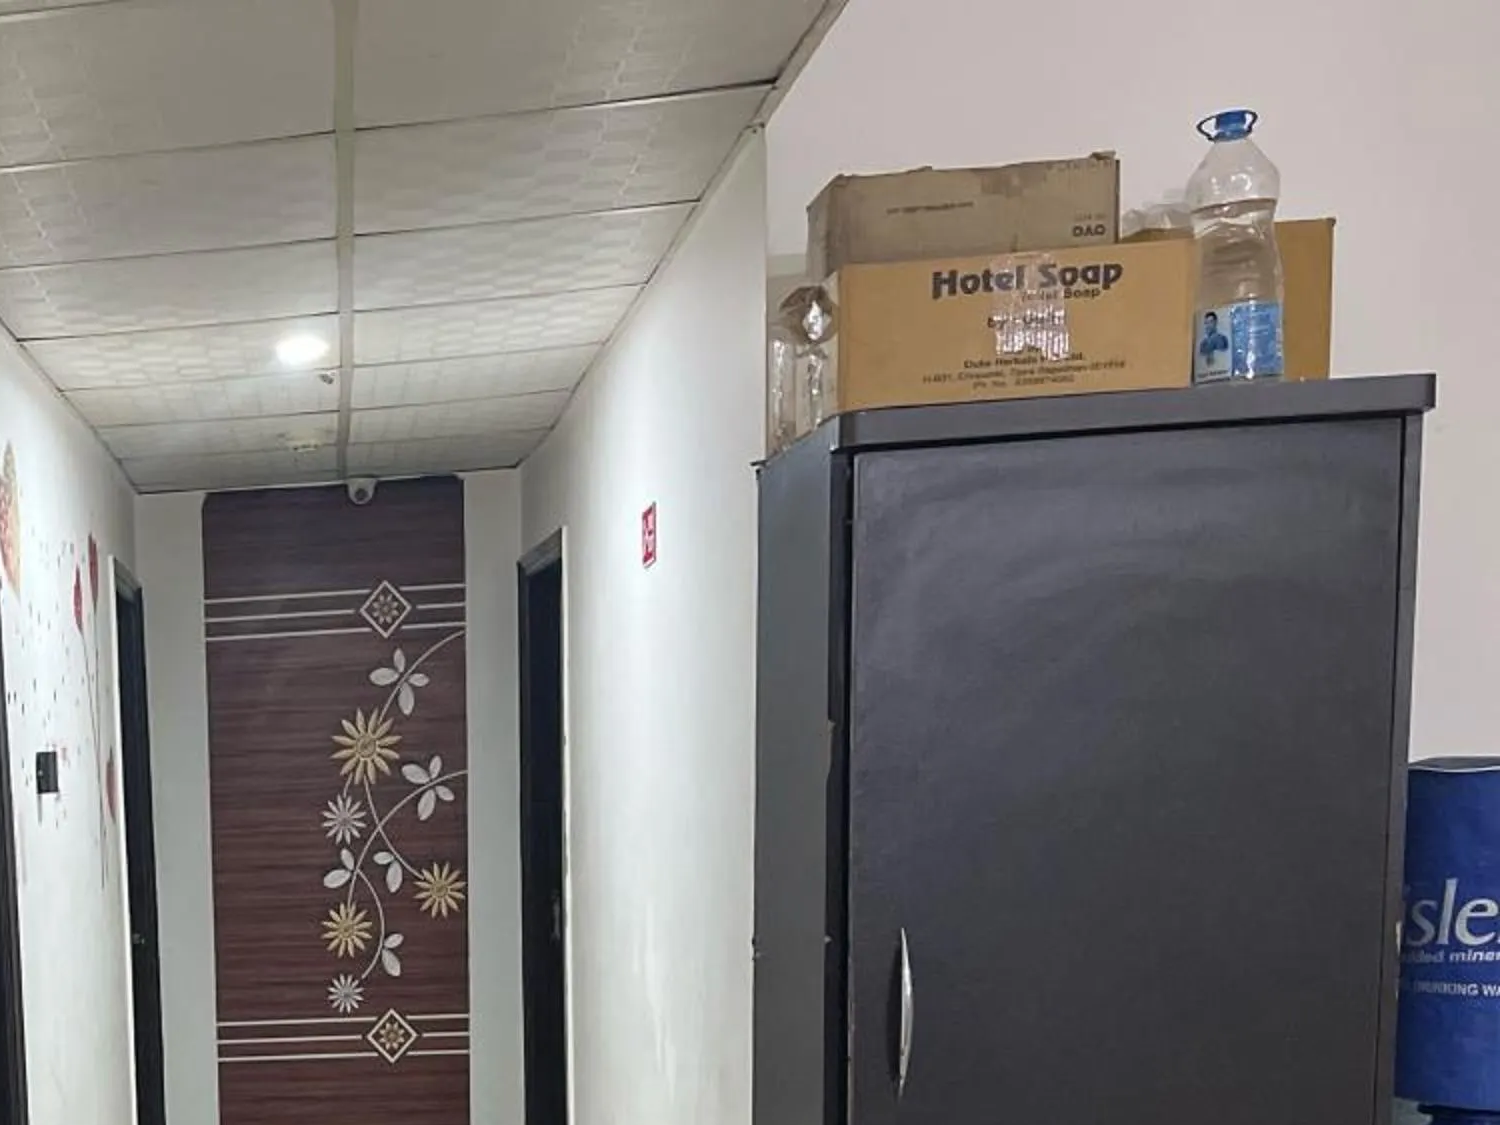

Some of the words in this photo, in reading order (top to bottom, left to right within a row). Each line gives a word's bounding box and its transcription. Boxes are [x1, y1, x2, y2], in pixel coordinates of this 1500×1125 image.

[932, 264, 1026, 300] Hotel
[1038, 263, 1124, 291] Soap
[1063, 287, 1102, 300] Soap
[1403, 877, 1500, 947] sle
